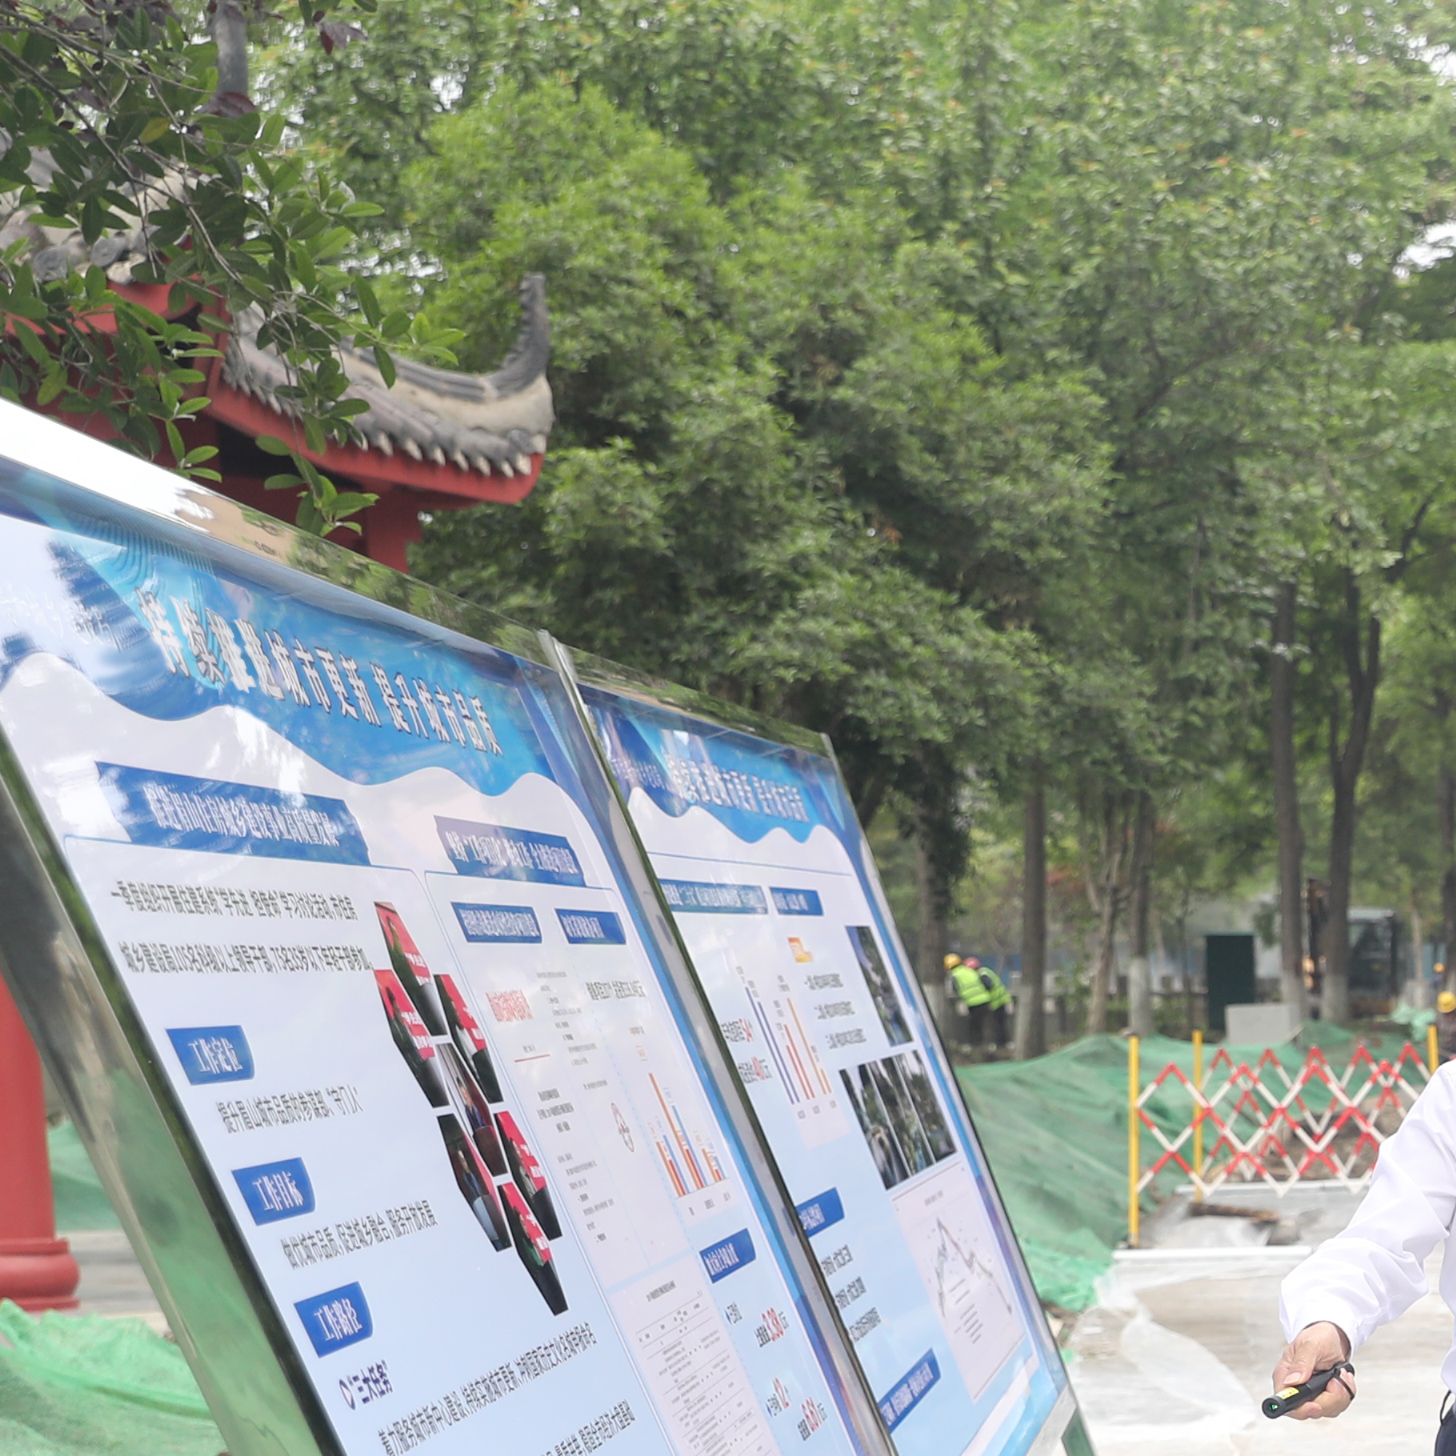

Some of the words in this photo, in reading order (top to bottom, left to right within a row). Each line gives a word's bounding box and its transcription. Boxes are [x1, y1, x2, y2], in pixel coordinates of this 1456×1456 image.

[129, 585, 385, 729] 持续推进城市更新
[366, 662, 505, 757] 提升城市品质
[185, 1035, 245, 1077] 工作定位
[250, 1169, 307, 1217] 工作目标
[311, 1295, 365, 1347] 工作路径
[346, 1360, 398, 1409] “三大任务”
